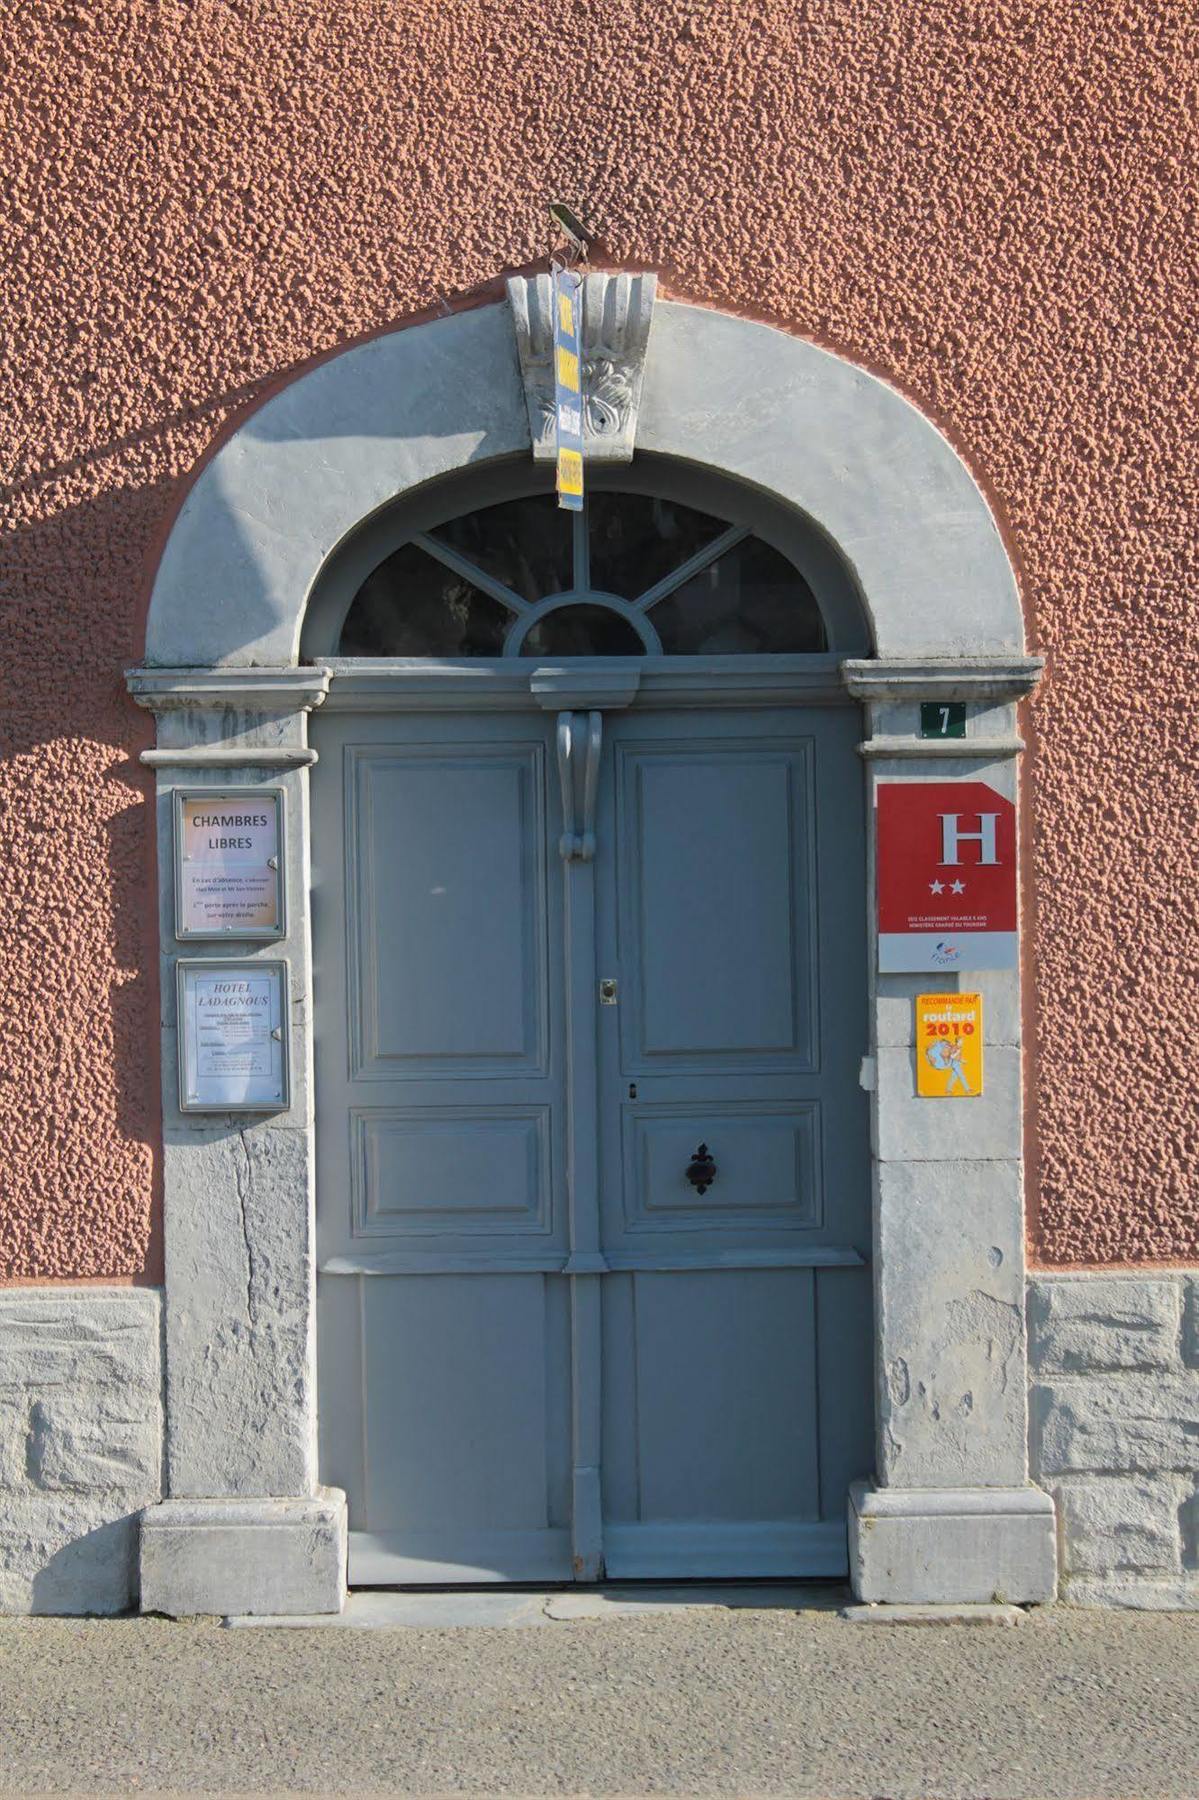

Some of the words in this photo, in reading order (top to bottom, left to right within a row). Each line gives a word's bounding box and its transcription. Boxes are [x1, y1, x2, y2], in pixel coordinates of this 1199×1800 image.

[939, 707, 950, 734] 7
[192, 815, 268, 828] CHAMBRES
[208, 837, 253, 850] LIBRES
[936, 812, 1002, 866] H
[214, 983, 252, 993] HOTEL
[198, 995, 269, 1007] LADAGNOUS
[922, 1009, 976, 1022] routard
[926, 1023, 975, 1036] 2010
